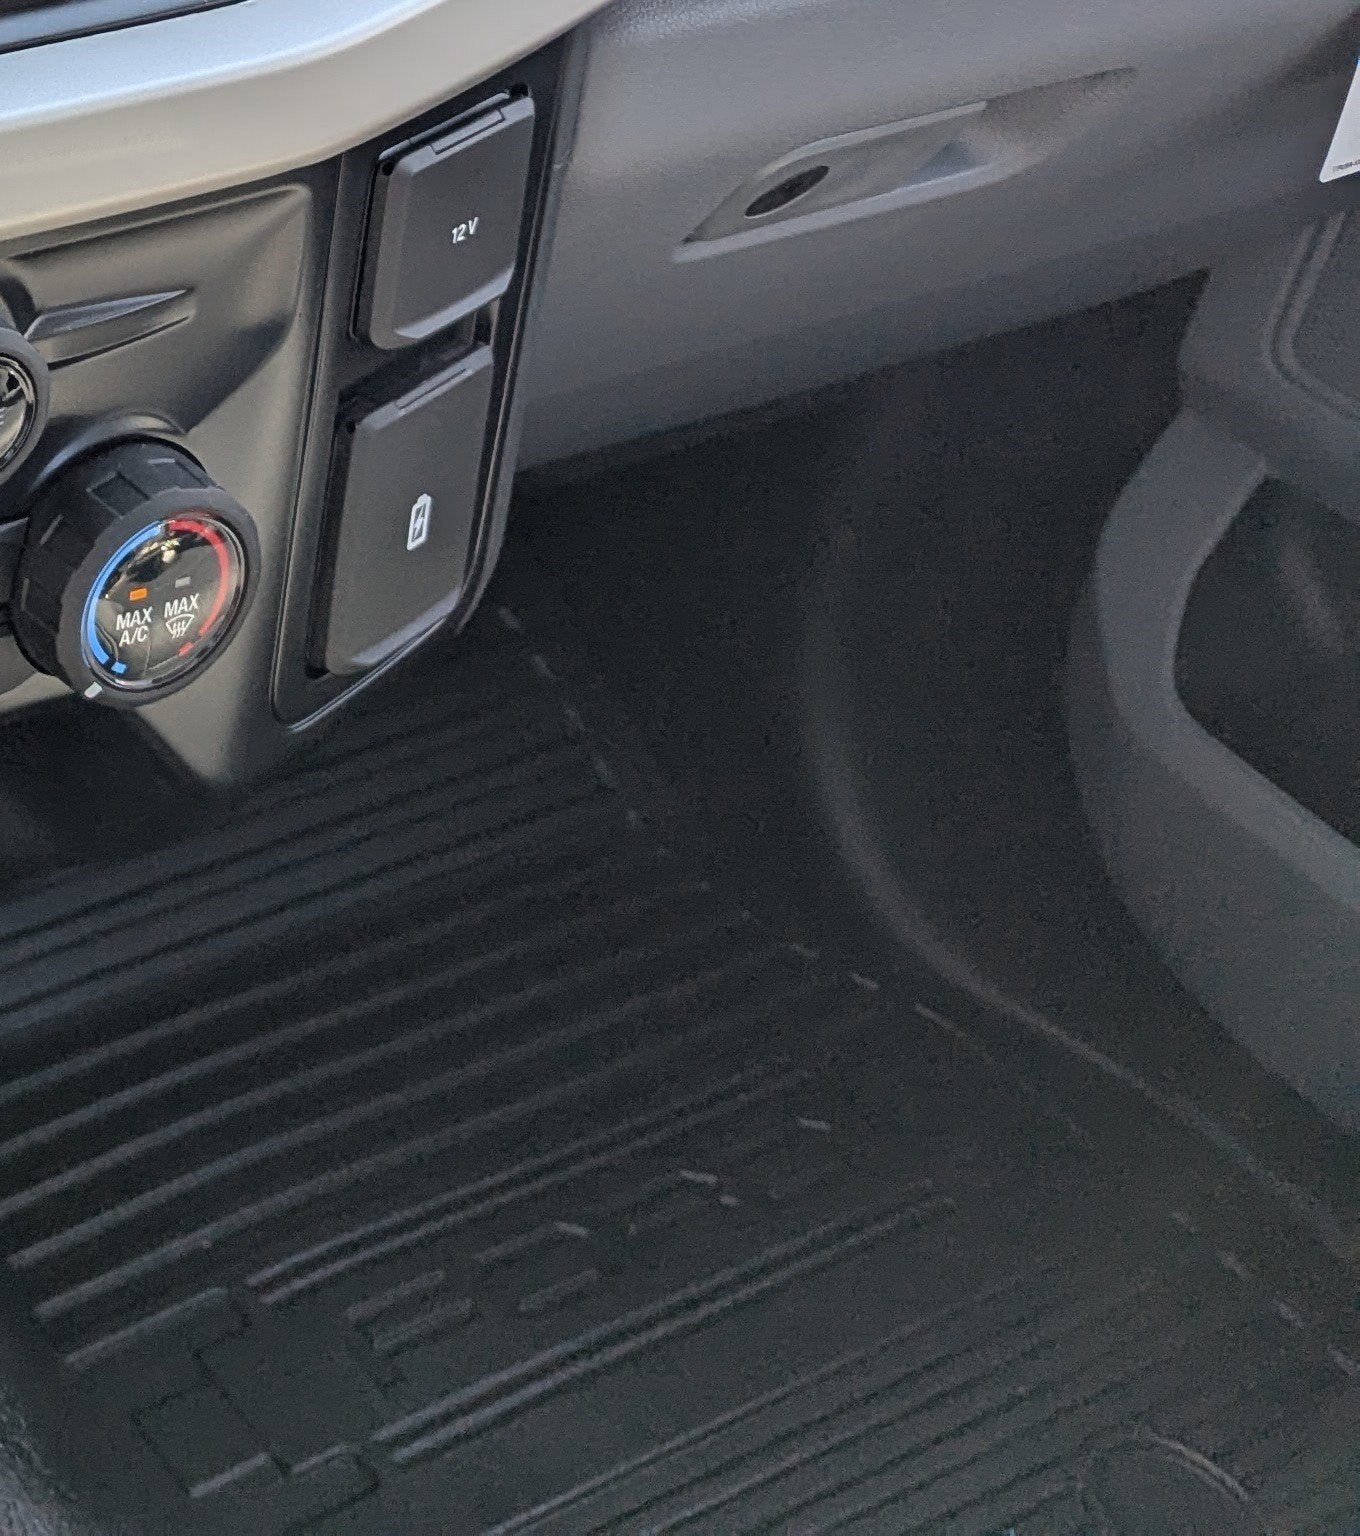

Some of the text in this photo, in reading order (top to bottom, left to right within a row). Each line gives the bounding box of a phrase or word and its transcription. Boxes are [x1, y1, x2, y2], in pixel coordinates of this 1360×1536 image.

[163, 592, 200, 619] MAX
[116, 606, 153, 631] MAX
[118, 626, 148, 647] A/C
